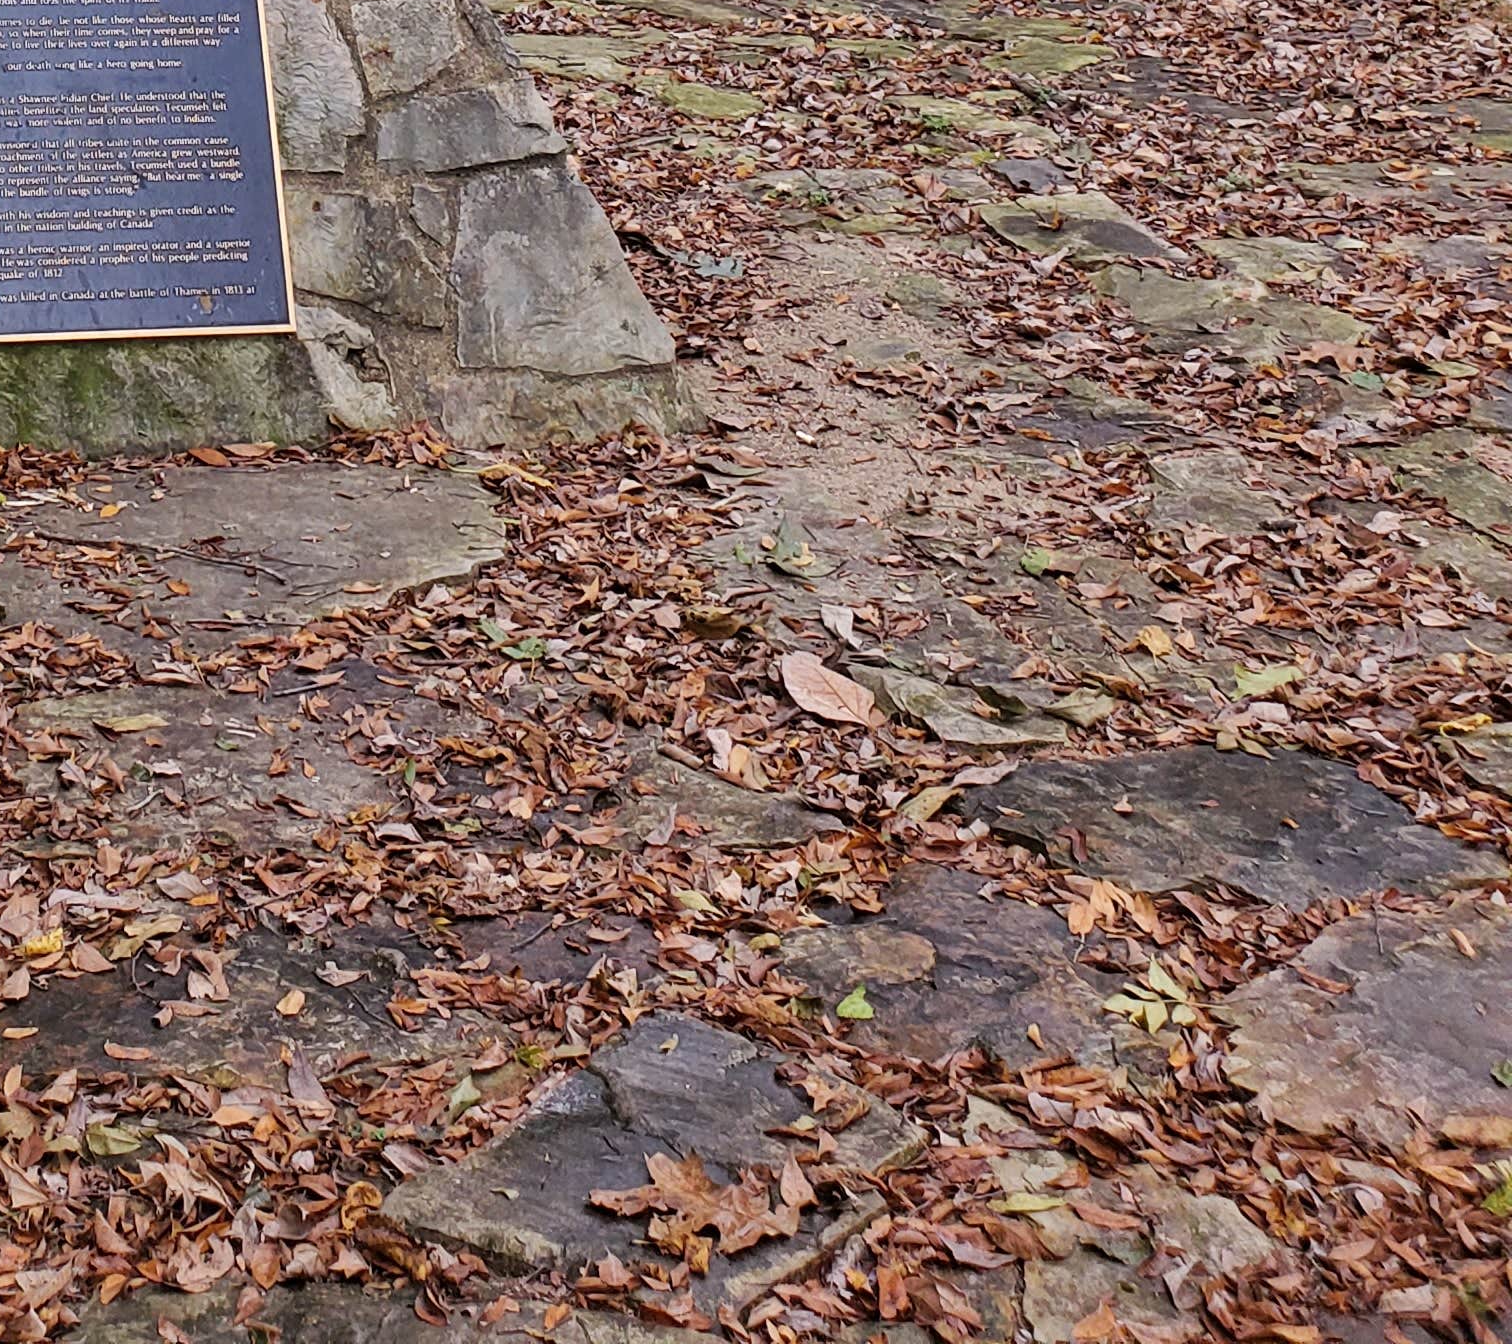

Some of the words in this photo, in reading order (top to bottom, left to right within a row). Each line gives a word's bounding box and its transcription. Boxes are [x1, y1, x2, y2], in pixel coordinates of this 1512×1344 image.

[18, 210, 32, 219] his
[35, 208, 70, 219] wisdom
[72, 208, 90, 218] and
[93, 206, 136, 219] teachings
[138, 206, 147, 216] is
[149, 205, 174, 218] given
[175, 204, 203, 215] credit
[219, 203, 236, 213] the
[3, 222, 13, 232] in
[16, 222, 32, 232] the
[35, 221, 64, 231] nation
[67, 220, 103, 232] building
[105, 219, 117, 229] of
[119, 218, 153, 229] Canada
[1, 257, 15, 267] He
[15, 258, 34, 267] was
[36, 254, 87, 266] considered
[89, 256, 96, 264] a
[98, 253, 134, 266] prophet
[137, 252, 149, 263] of
[151, 252, 166, 262] his
[167, 251, 200, 263] people
[201, 249, 248, 262] predicting
[27, 268, 38, 278] of
[0, 294, 17, 302] was
[20, 291, 46, 301] killed
[48, 290, 58, 300] in
[61, 289, 95, 300] Canada
[98, 289, 108, 299] at
[109, 288, 125, 298] the
[128, 287, 156, 298] battle
[158, 287, 169, 297] of
[210, 285, 221, 295] in
[245, 284, 255, 293] at
